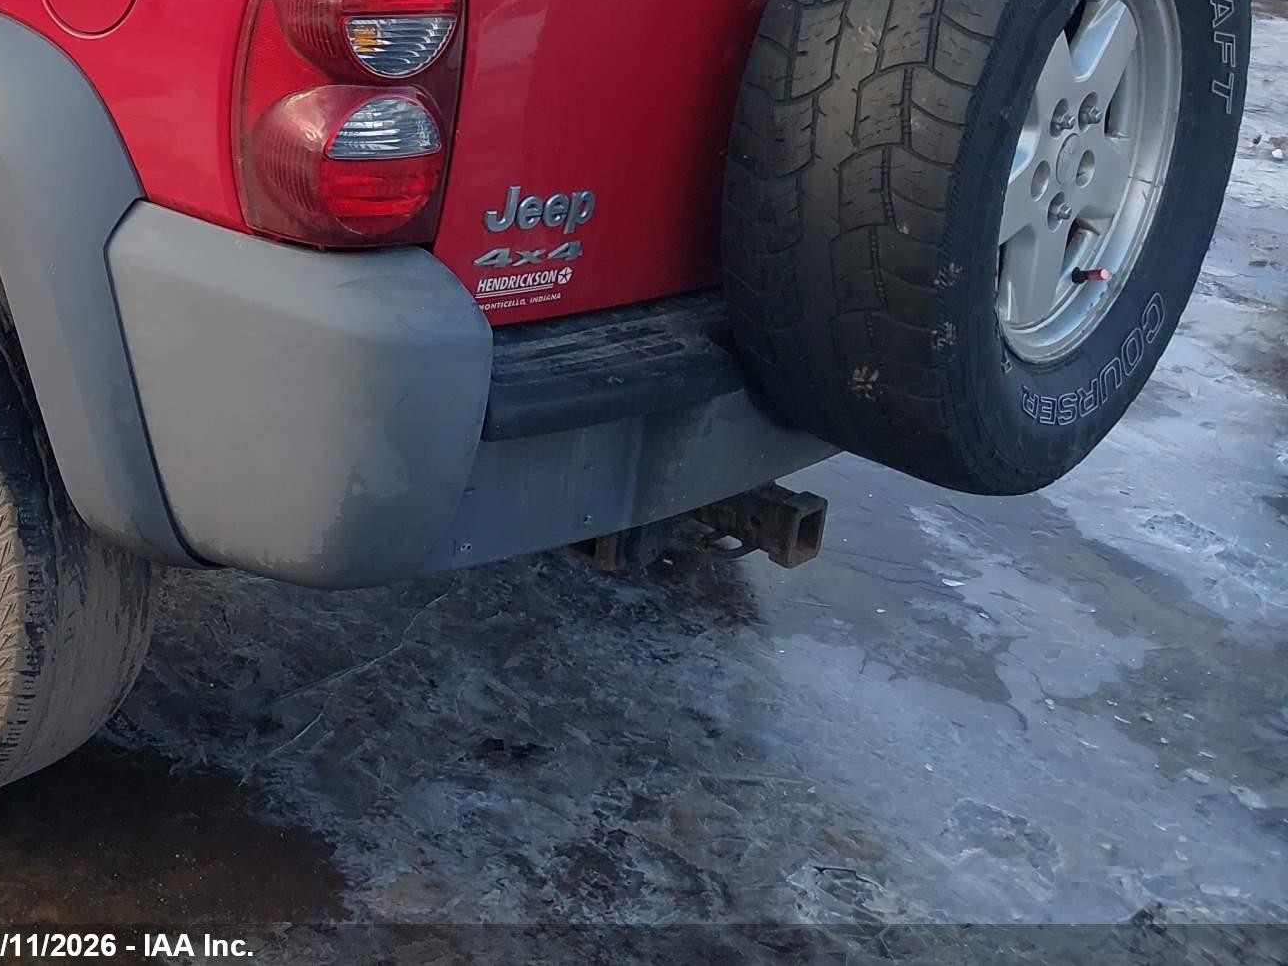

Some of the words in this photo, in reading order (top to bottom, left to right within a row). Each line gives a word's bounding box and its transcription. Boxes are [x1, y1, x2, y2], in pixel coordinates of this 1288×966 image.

[484, 185, 595, 234] Jeep
[473, 240, 583, 268] 4x4
[476, 269, 557, 292] HENDRICKSON
[529, 292, 562, 304] INDIANA
[1021, 292, 1165, 426] COURSER
